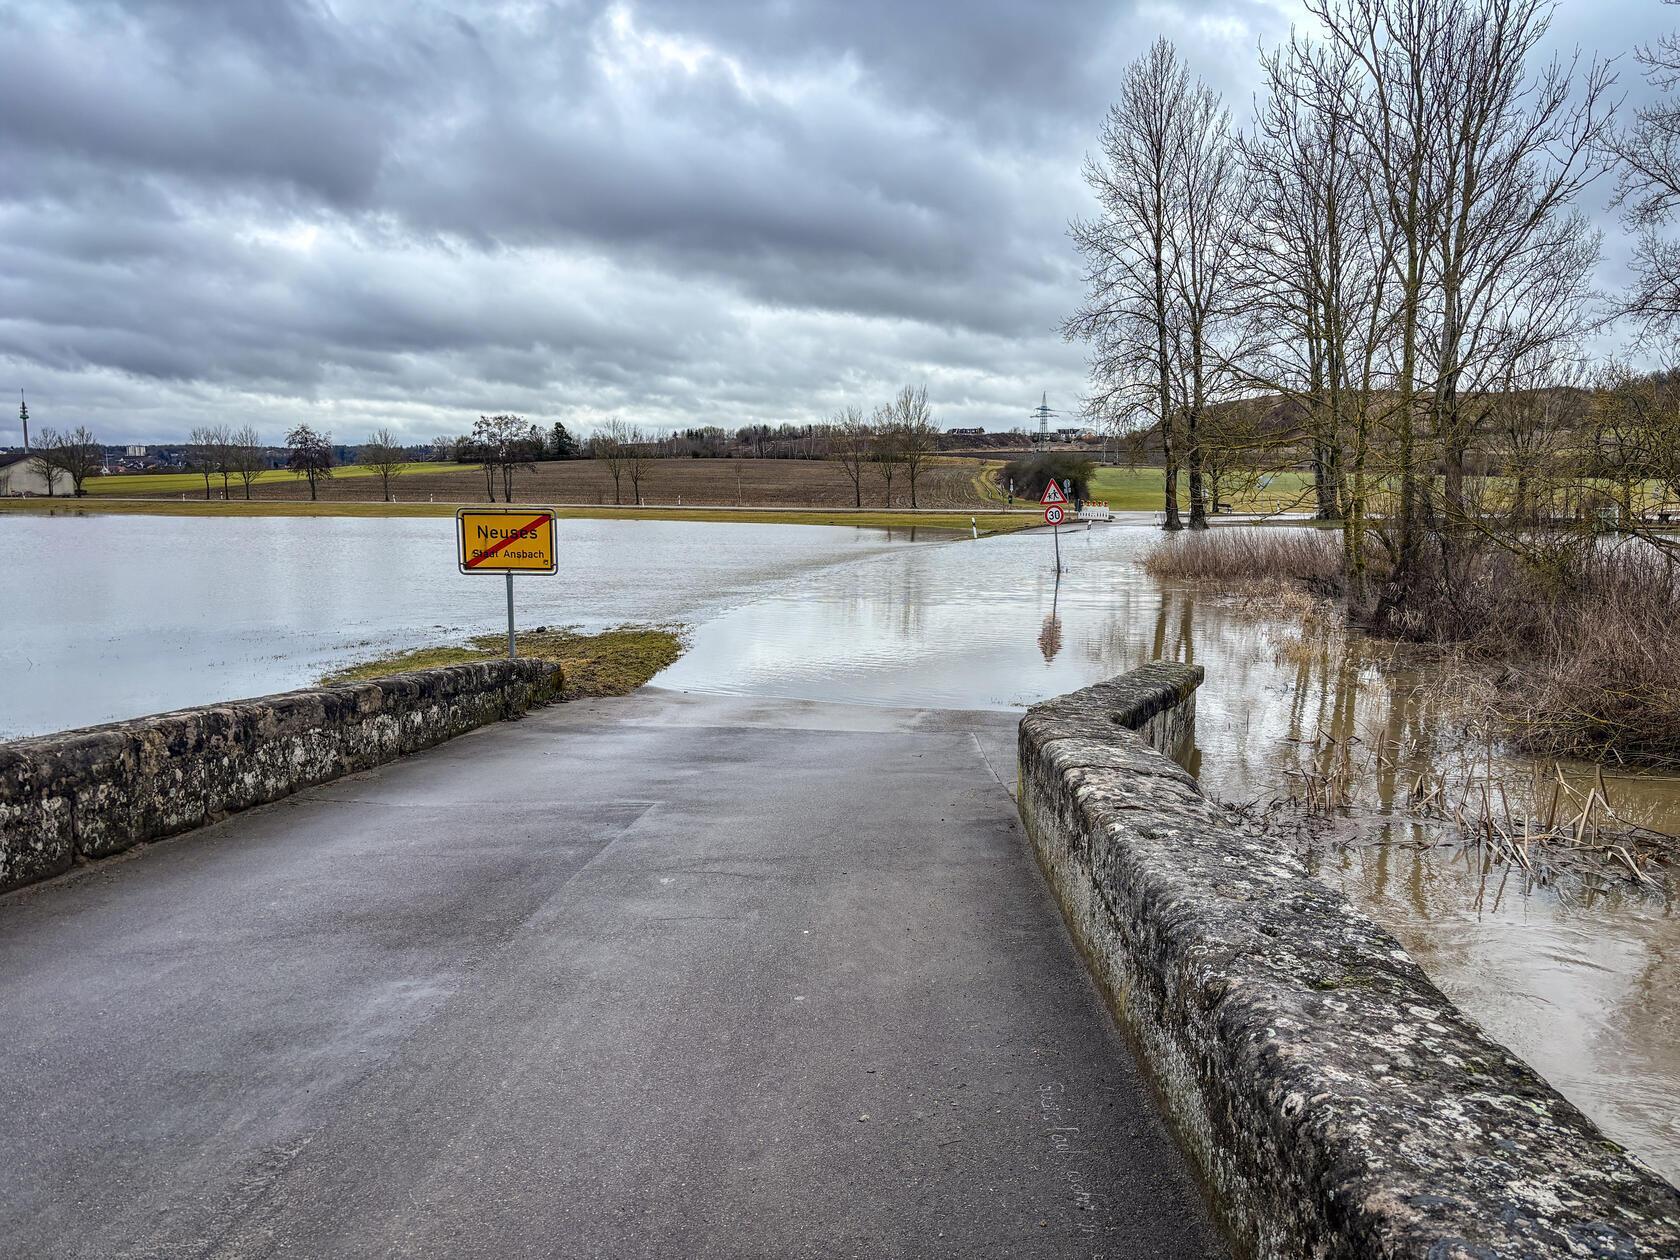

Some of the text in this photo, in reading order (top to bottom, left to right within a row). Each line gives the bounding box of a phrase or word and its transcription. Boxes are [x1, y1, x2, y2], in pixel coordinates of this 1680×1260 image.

[1048, 510, 1060, 520] 30
[477, 525, 538, 539] Neuses
[503, 549, 545, 559] Ansbach
